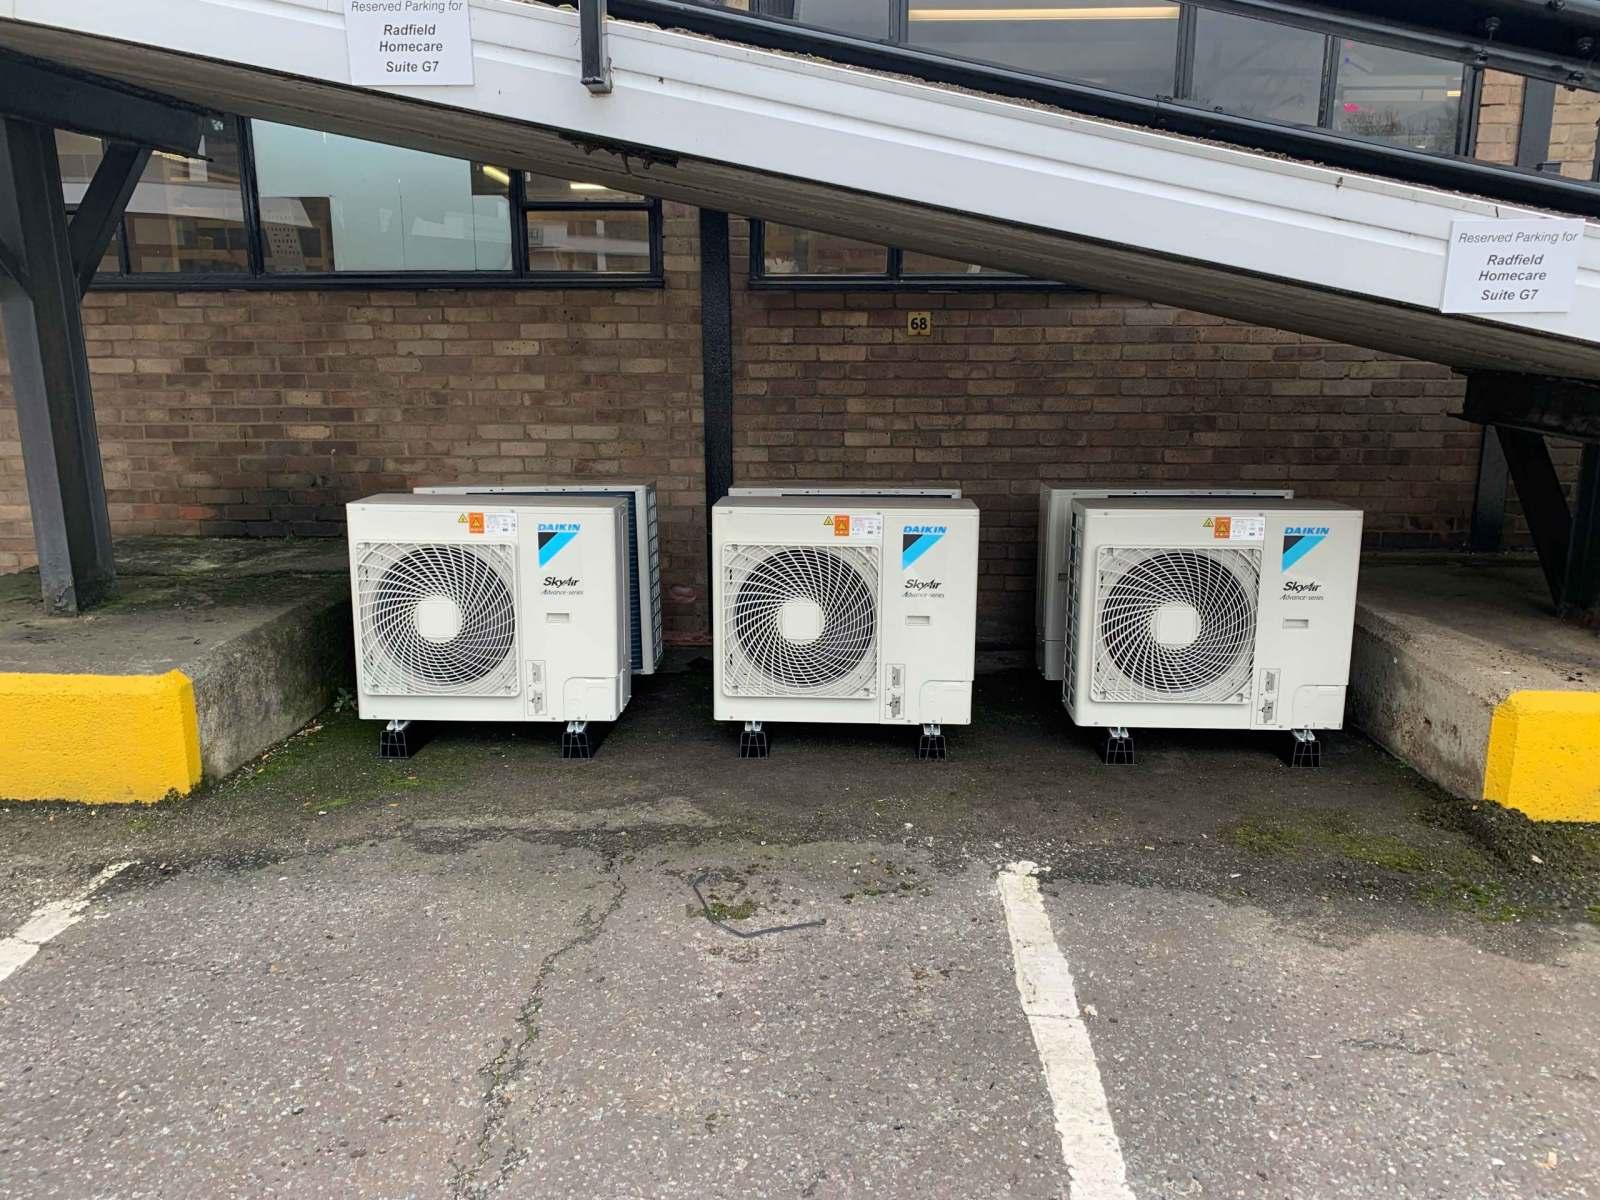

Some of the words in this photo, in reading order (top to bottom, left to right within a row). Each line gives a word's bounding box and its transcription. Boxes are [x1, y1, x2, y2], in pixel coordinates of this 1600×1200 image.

[351, 0, 402, 12] Reserved
[405, 0, 445, 13] Parking
[448, 0, 464, 11] for
[383, 24, 436, 36] Radfield
[379, 41, 443, 52] Homecare
[386, 61, 418, 72] Suite
[422, 61, 440, 72] G7
[1458, 232, 1514, 243] Reserved
[1515, 231, 1559, 245] Parking
[1562, 232, 1579, 242] for
[1486, 254, 1545, 266] Radfield
[1478, 270, 1547, 281] Homecare
[1481, 289, 1516, 301] Suite
[1519, 289, 1539, 301] G7
[910, 317, 928, 330] 68
[538, 523, 581, 531] DAIKIN
[903, 525, 947, 533] DAIKIN
[1284, 527, 1330, 535] DAIKIN
